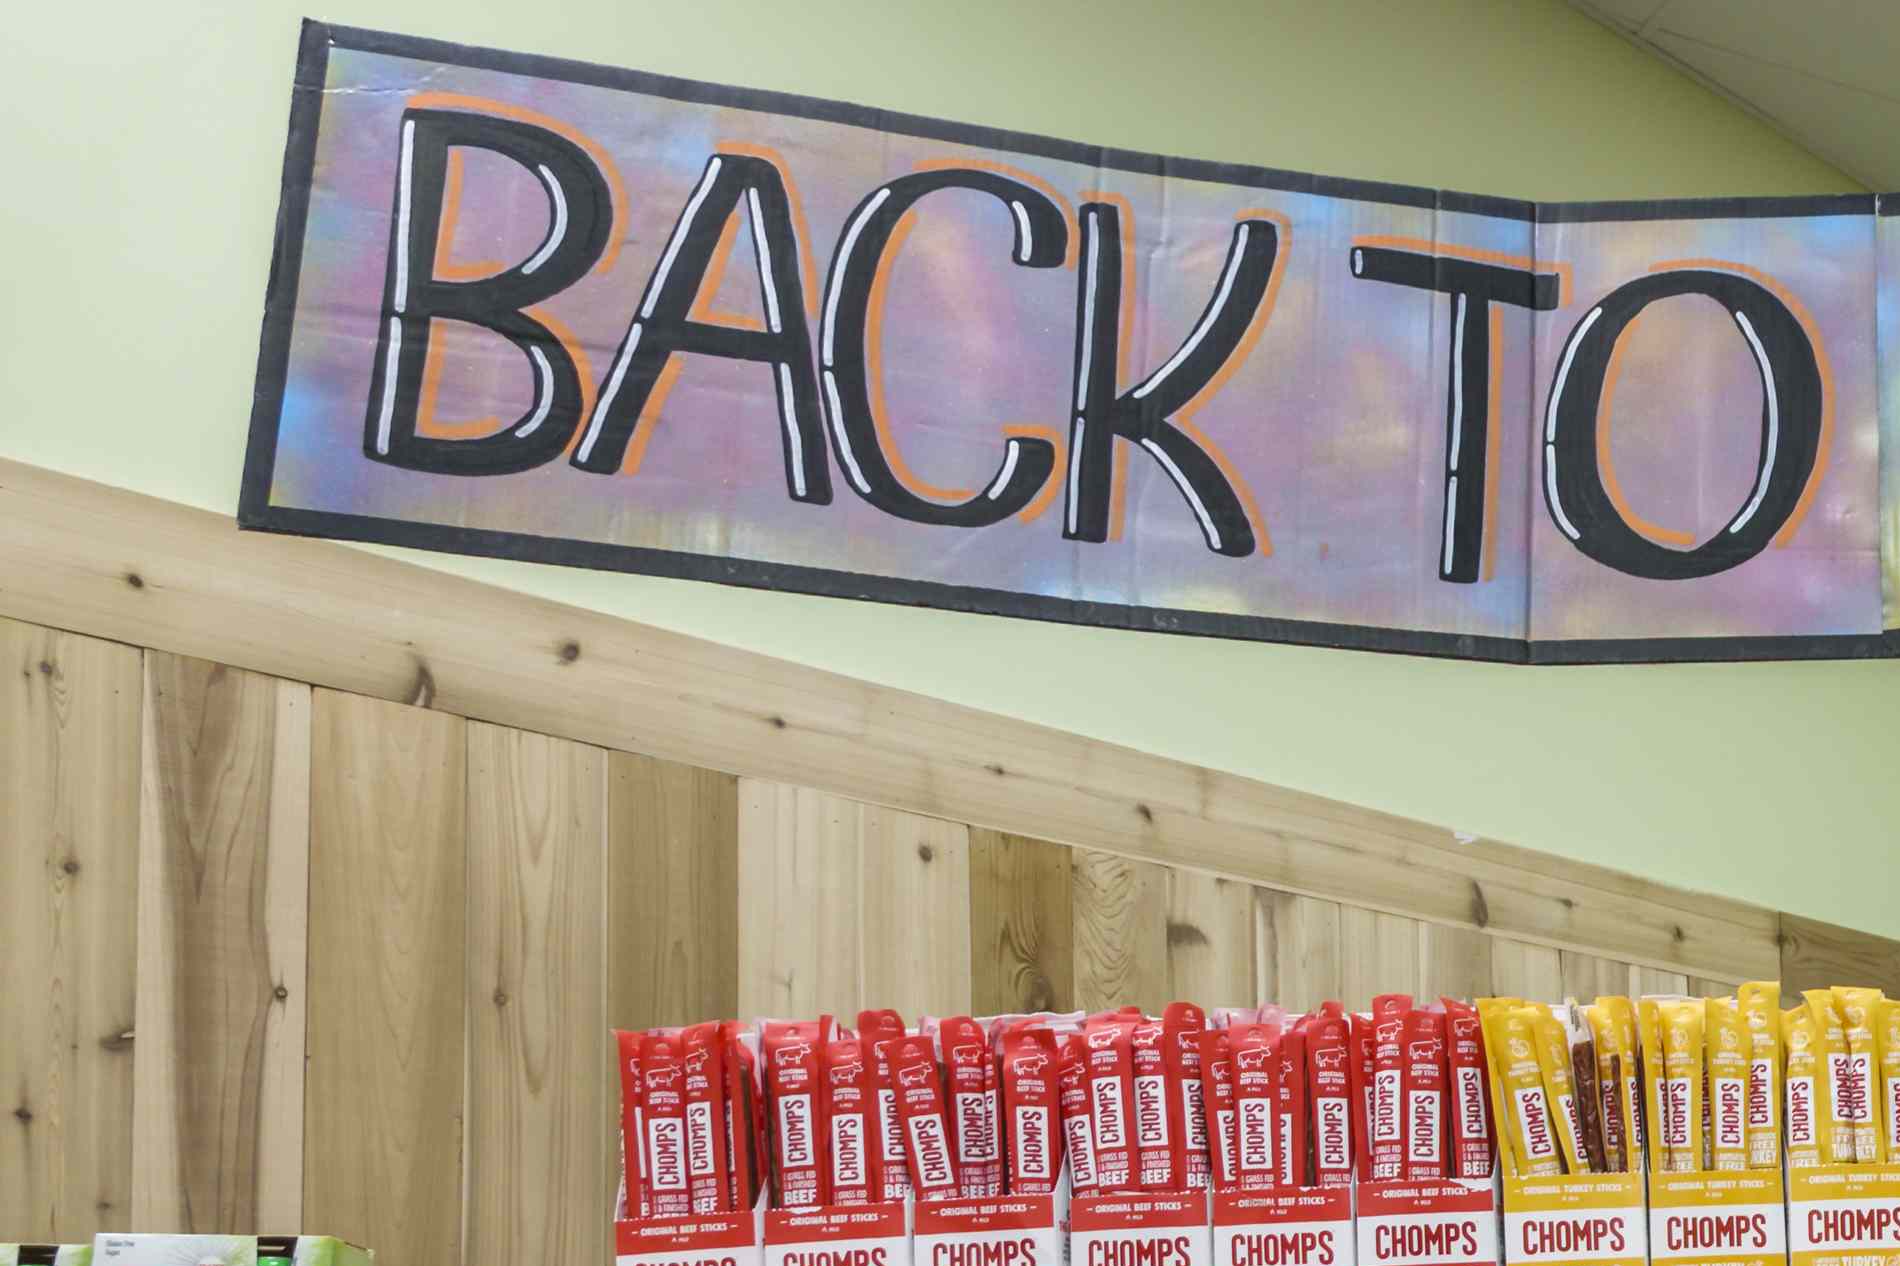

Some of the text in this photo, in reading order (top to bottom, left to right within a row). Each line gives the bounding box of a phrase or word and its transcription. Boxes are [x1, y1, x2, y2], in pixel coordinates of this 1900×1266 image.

[363, 106, 1273, 555] BACK
[1350, 244, 1828, 584] TO
[785, 1098, 807, 1163] CHOMPS
[1098, 1081, 1120, 1145] CHOMPS
[1245, 1103, 1267, 1165] CHOMPS
[1523, 1091, 1553, 1156] CHOMPS
[655, 1122, 680, 1185] CHOMPS
[1376, 1221, 1477, 1259] CHOMPS
[1523, 1218, 1624, 1255] CHOMPS
[1668, 1214, 1766, 1250] CHOMPS
